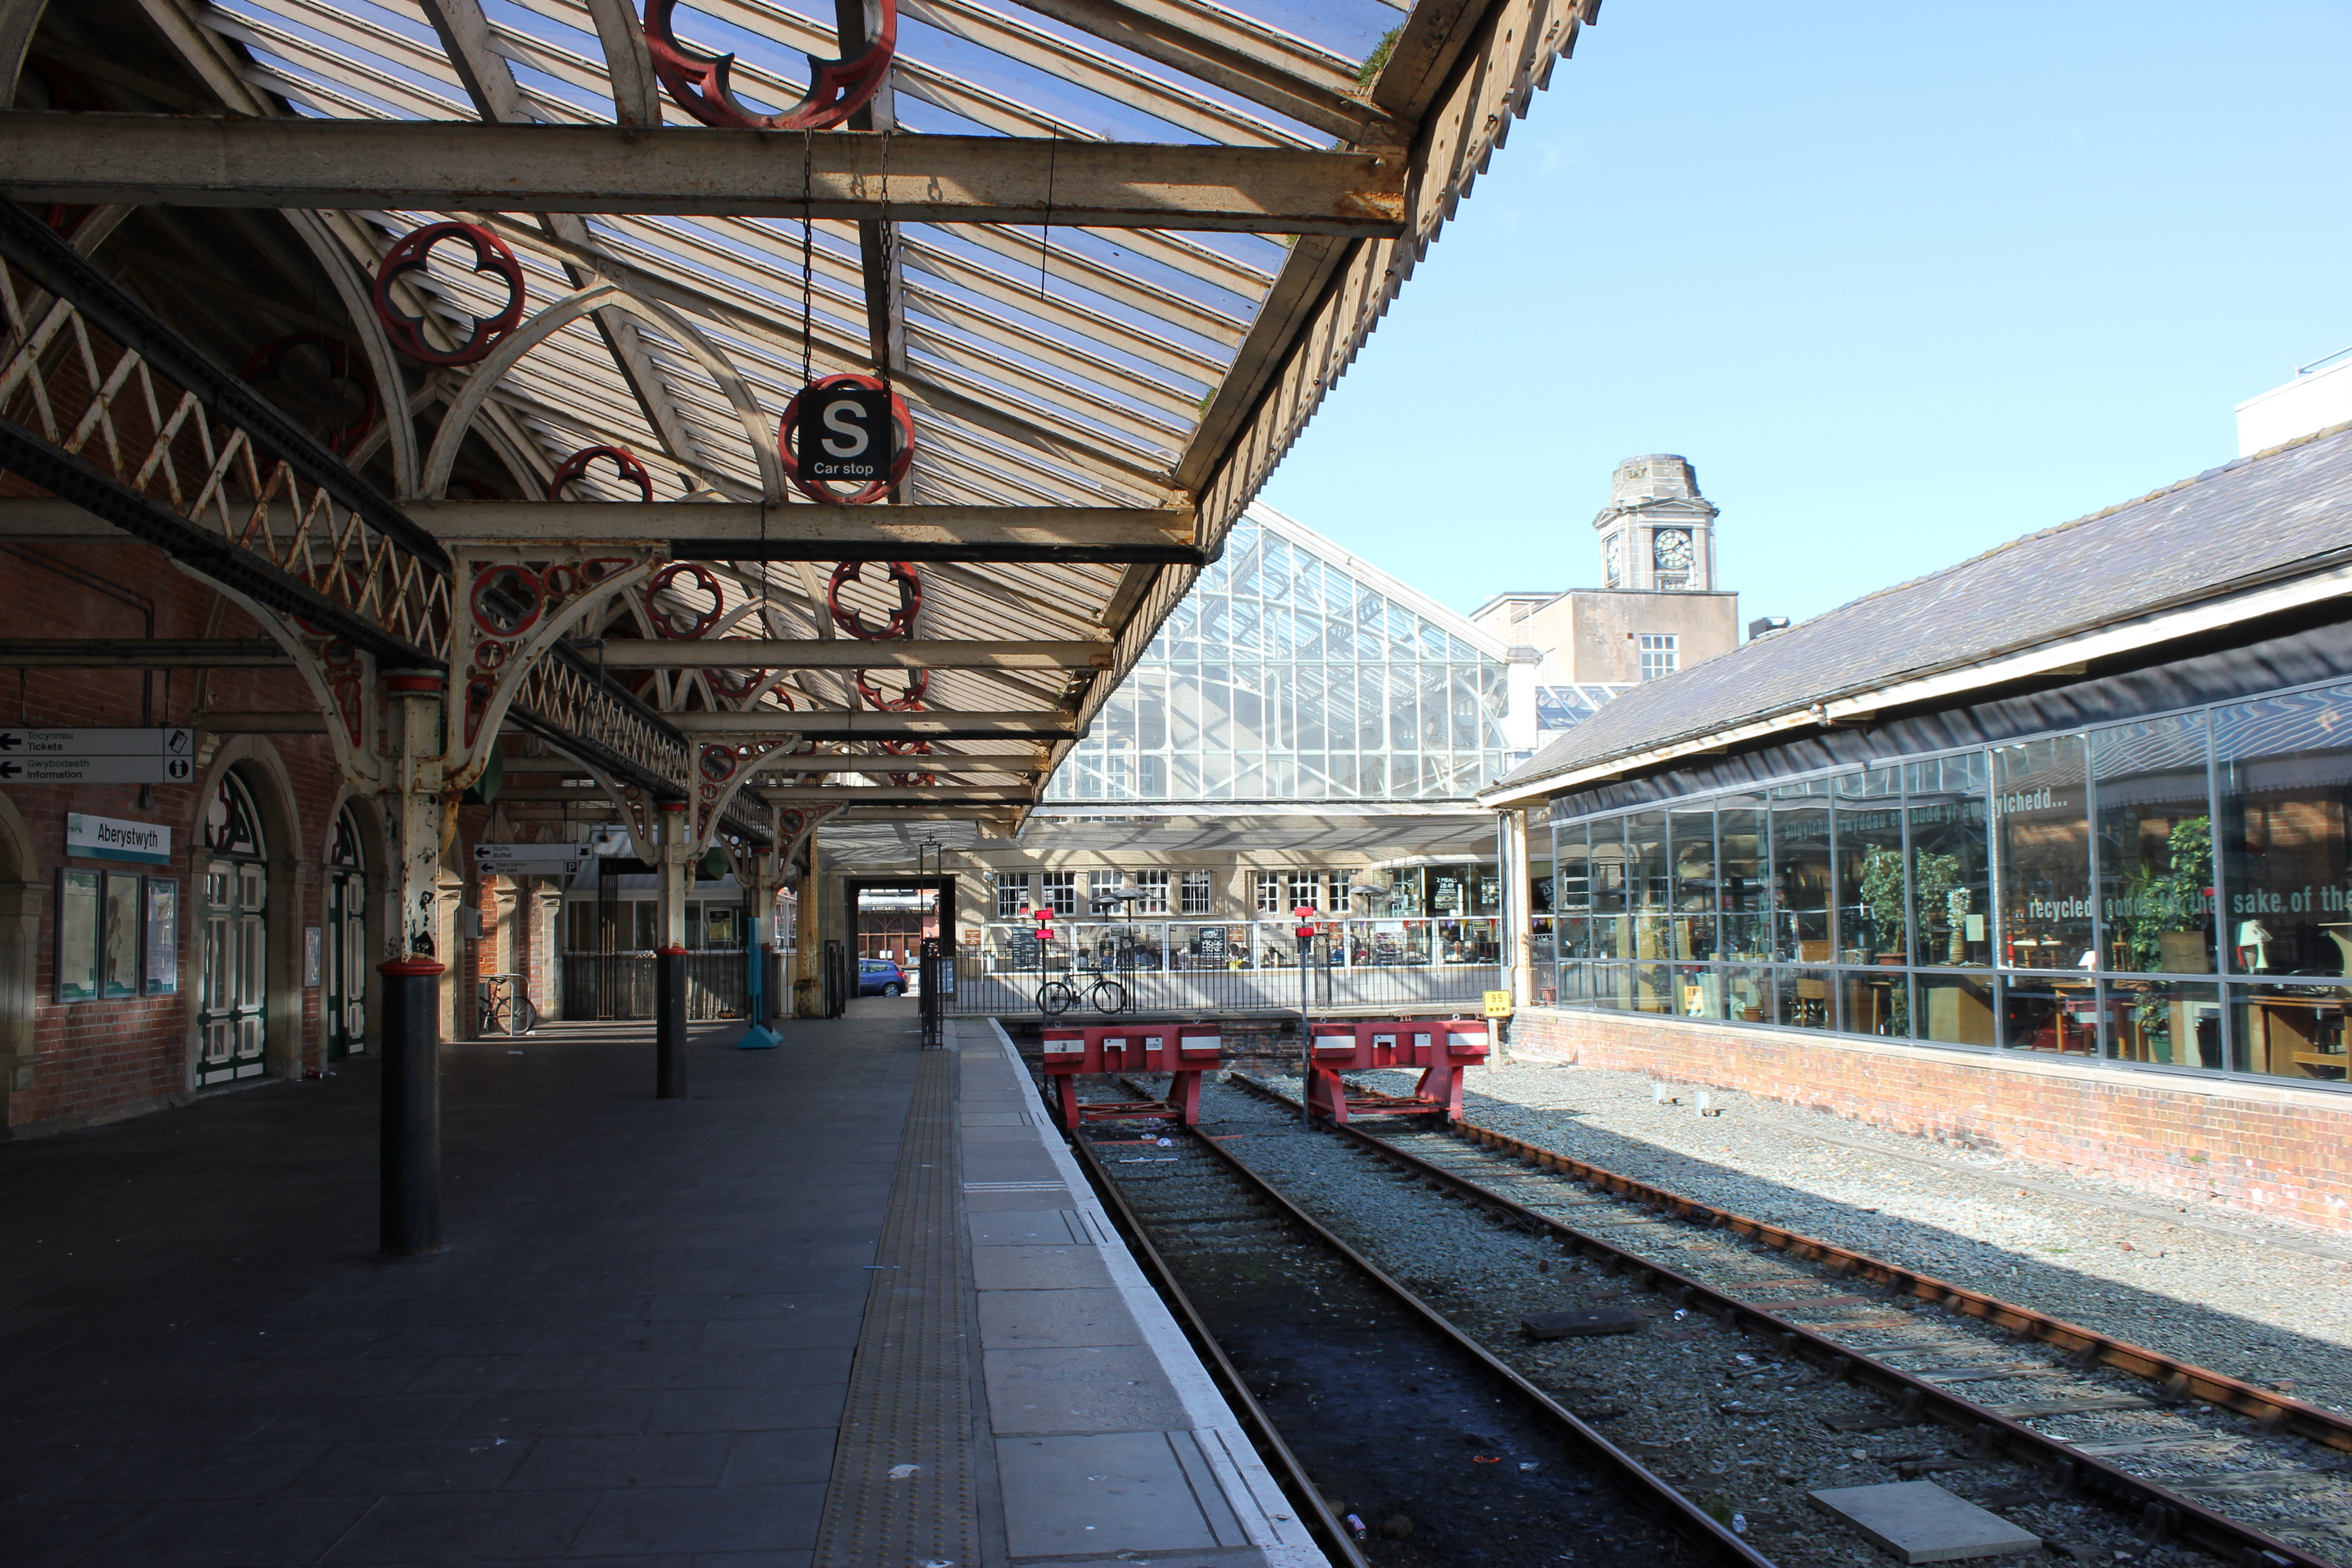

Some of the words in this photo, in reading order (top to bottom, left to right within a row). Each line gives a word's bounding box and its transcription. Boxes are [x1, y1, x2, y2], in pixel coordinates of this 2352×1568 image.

[821, 399, 869, 457] S
[814, 462, 839, 474] Car
[843, 463, 874, 476] stop
[27, 731, 74, 741] Tocynnau
[27, 742, 63, 751] Tickets
[27, 760, 90, 769] Gwybodaeth
[27, 771, 82, 779] Information
[98, 823, 158, 849] Aberystwyth
[568, 862, 575, 872] P
[2029, 895, 2093, 923] recycled
[2233, 888, 2282, 913] sake
[2291, 886, 2312, 912] of
